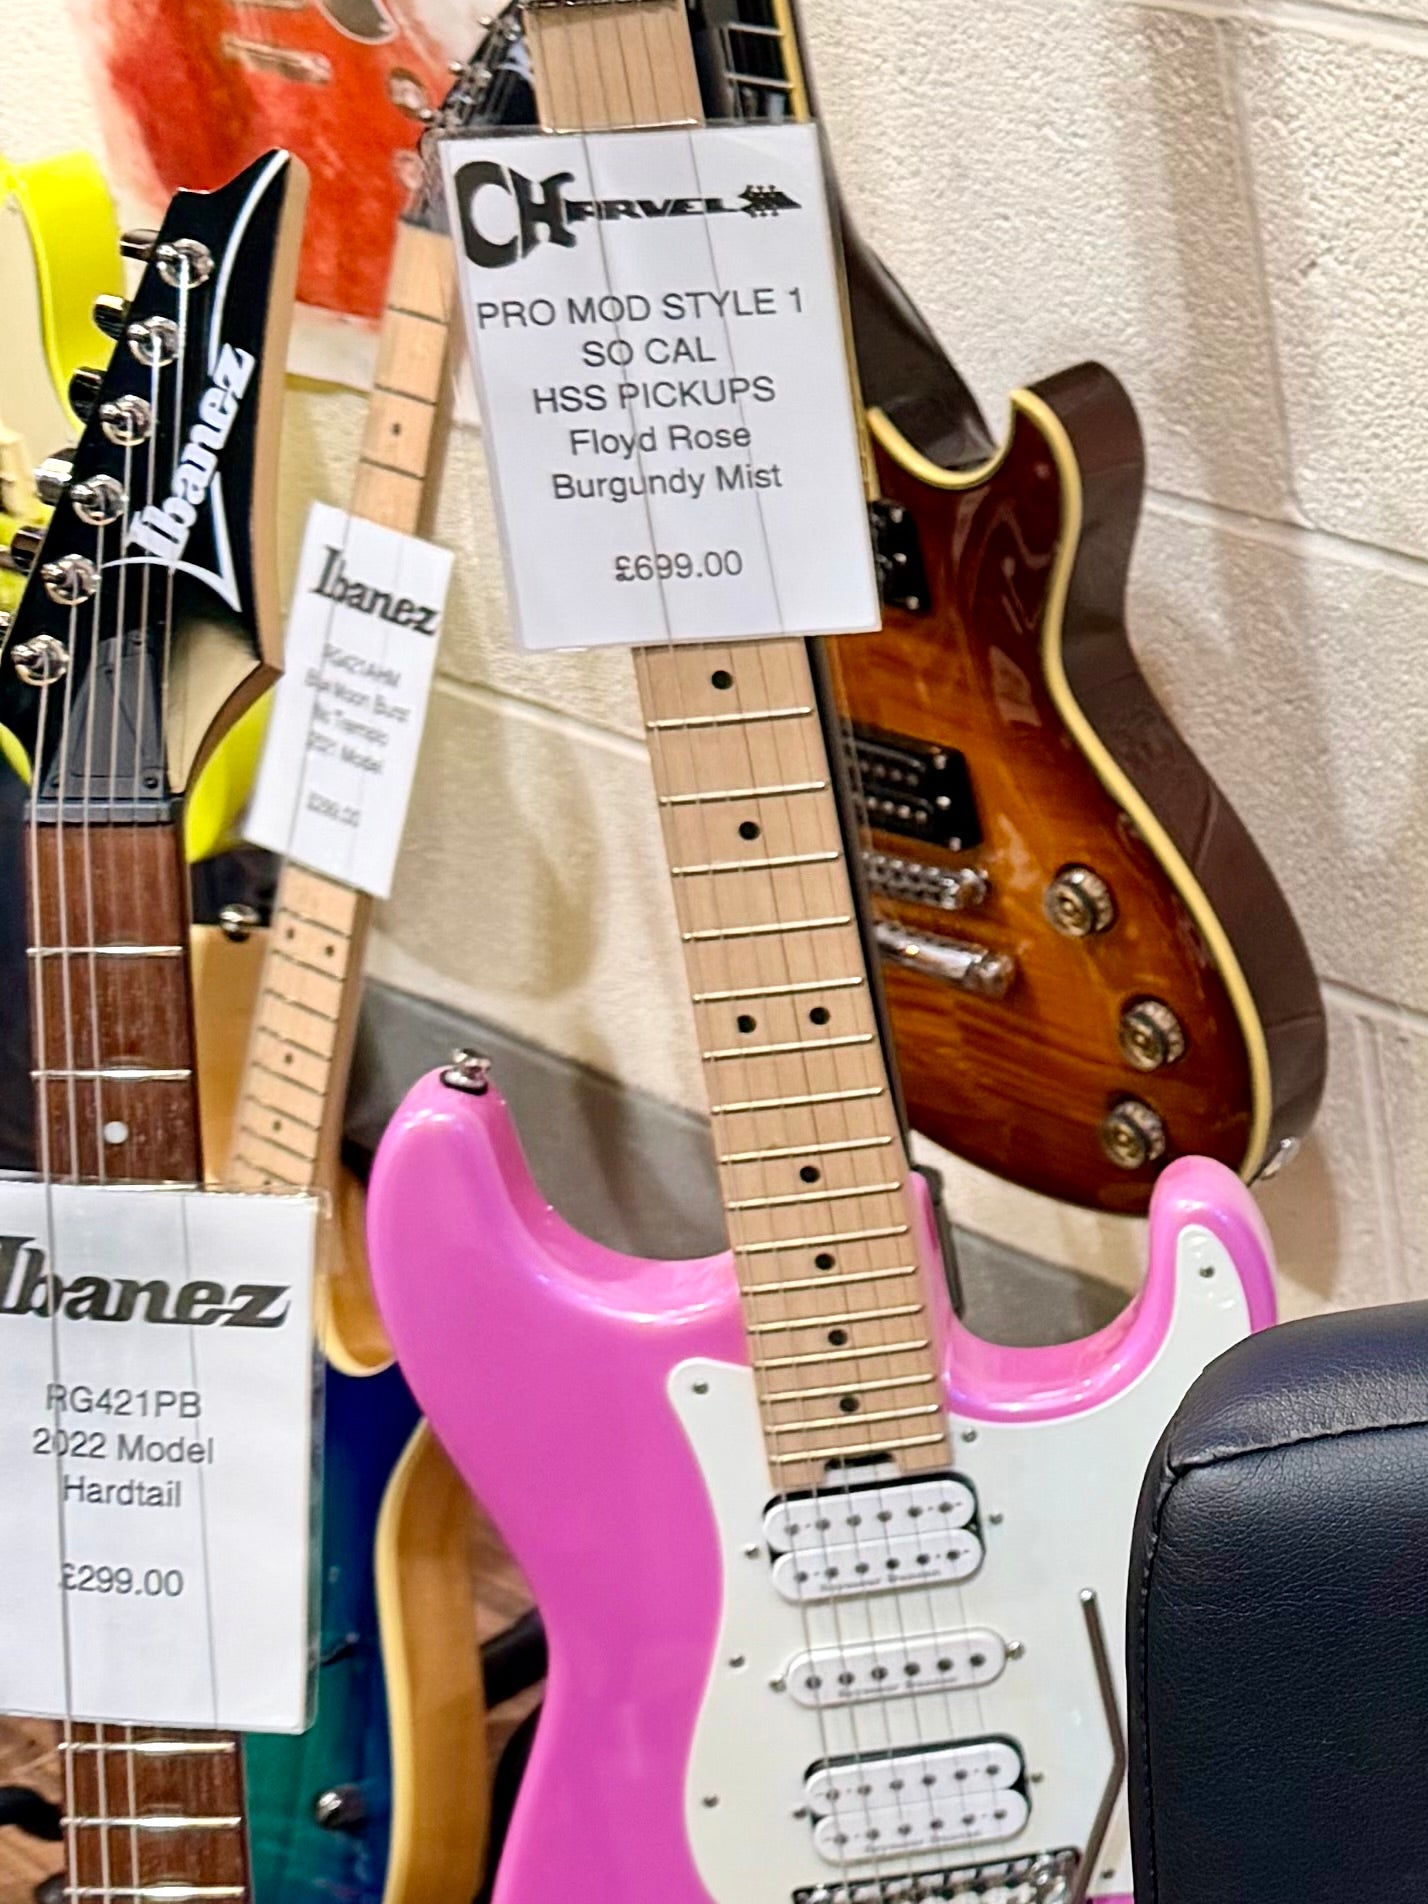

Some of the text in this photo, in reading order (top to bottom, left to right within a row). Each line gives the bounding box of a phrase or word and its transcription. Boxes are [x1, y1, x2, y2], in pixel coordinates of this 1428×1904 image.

[478, 286, 803, 330] PRO MOD STYLE 1
[582, 336, 716, 367] SO CAL
[533, 376, 776, 414] HSS PICKUPS
[128, 343, 256, 562] Ibanez
[570, 423, 751, 460] Floyd Rose
[553, 464, 783, 504] Burgundy Mist
[615, 550, 743, 582] £699.00
[311, 543, 441, 637] Ibanez
[46, 1385, 203, 1419] RG421PB
[33, 1428, 214, 1465] 2022 Model
[63, 1475, 182, 1508] Hardtail
[60, 1563, 183, 1597] £299.00
